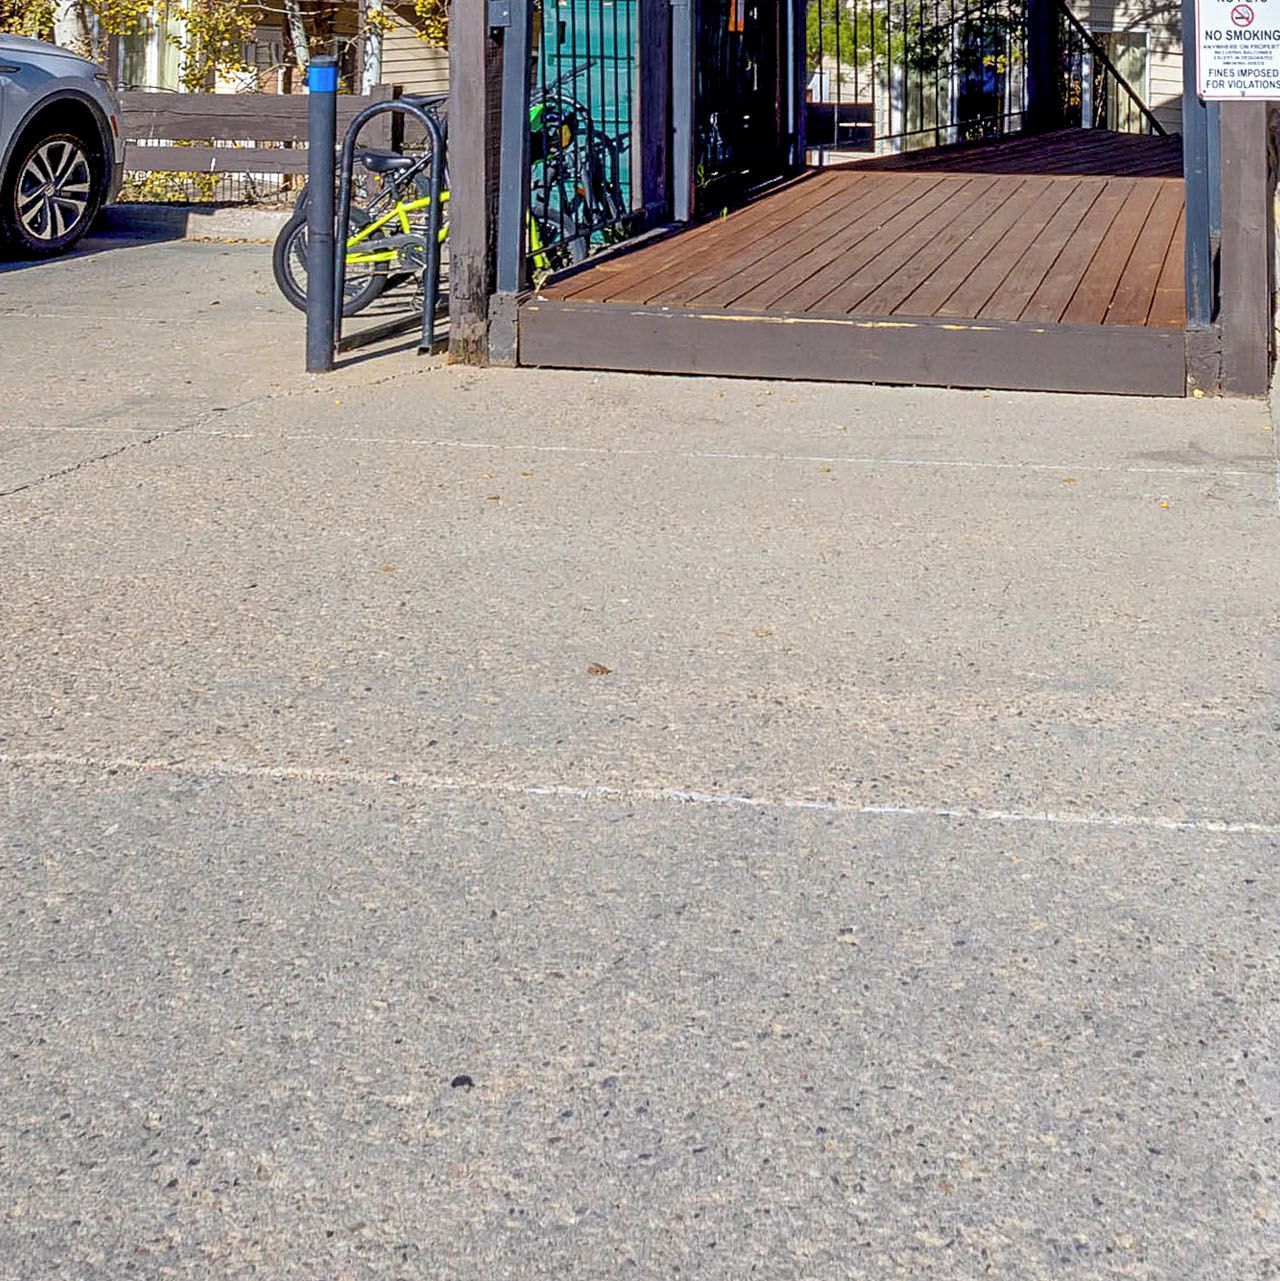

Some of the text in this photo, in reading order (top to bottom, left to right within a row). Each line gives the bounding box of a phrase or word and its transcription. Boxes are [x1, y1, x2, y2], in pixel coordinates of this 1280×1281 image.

[1205, 29, 1280, 41] NO SMOKING
[1208, 68, 1280, 78] FINES IMPOSED
[1206, 79, 1225, 89] FOR
